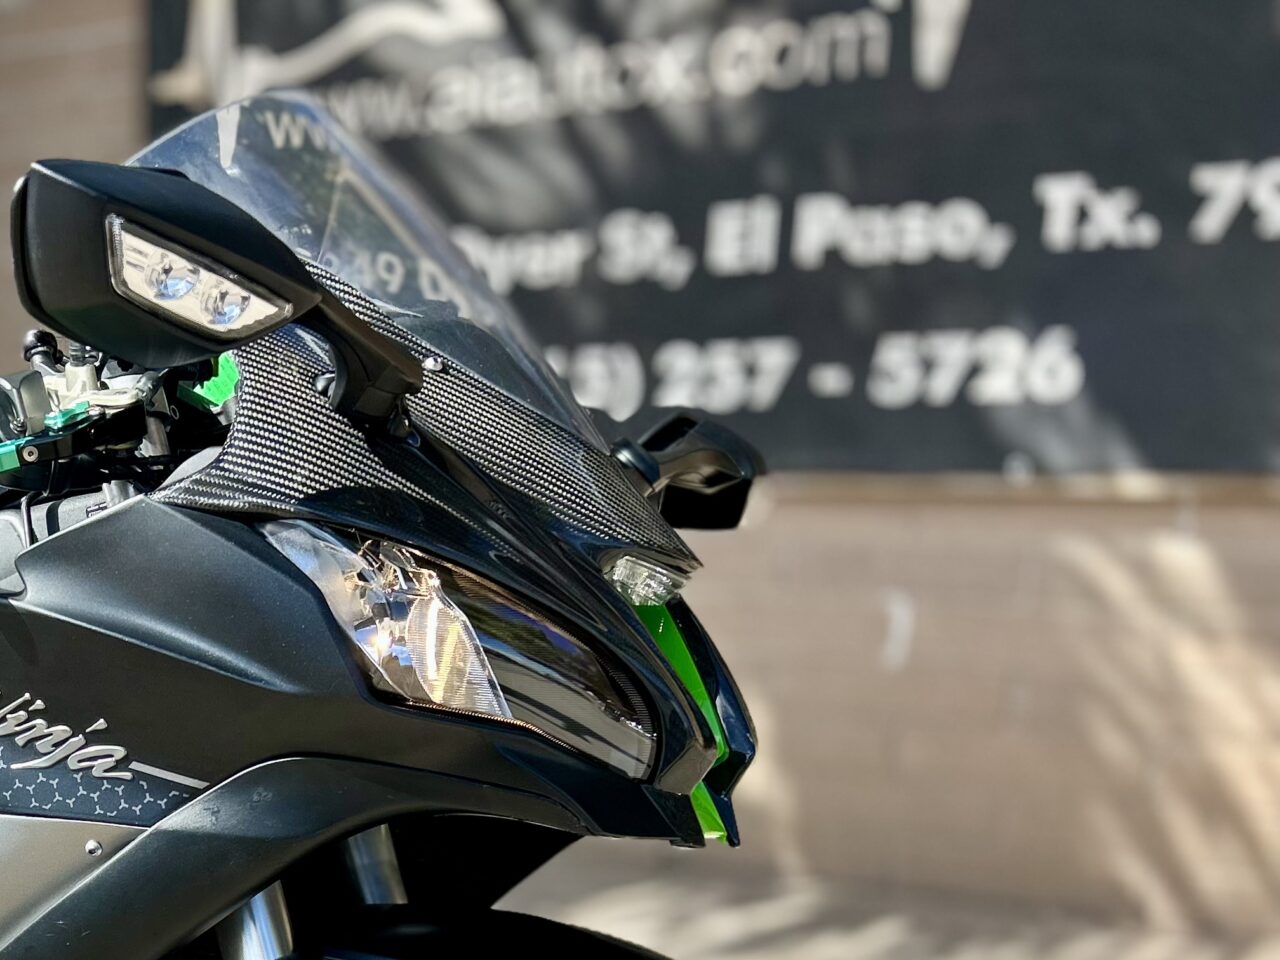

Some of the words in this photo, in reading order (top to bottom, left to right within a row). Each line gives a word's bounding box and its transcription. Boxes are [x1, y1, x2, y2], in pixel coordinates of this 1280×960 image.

[704, 195, 782, 277] El
[789, 193, 1015, 269] Paso,
[1032, 169, 1162, 253] Tx.
[865, 326, 1086, 410] 5726
